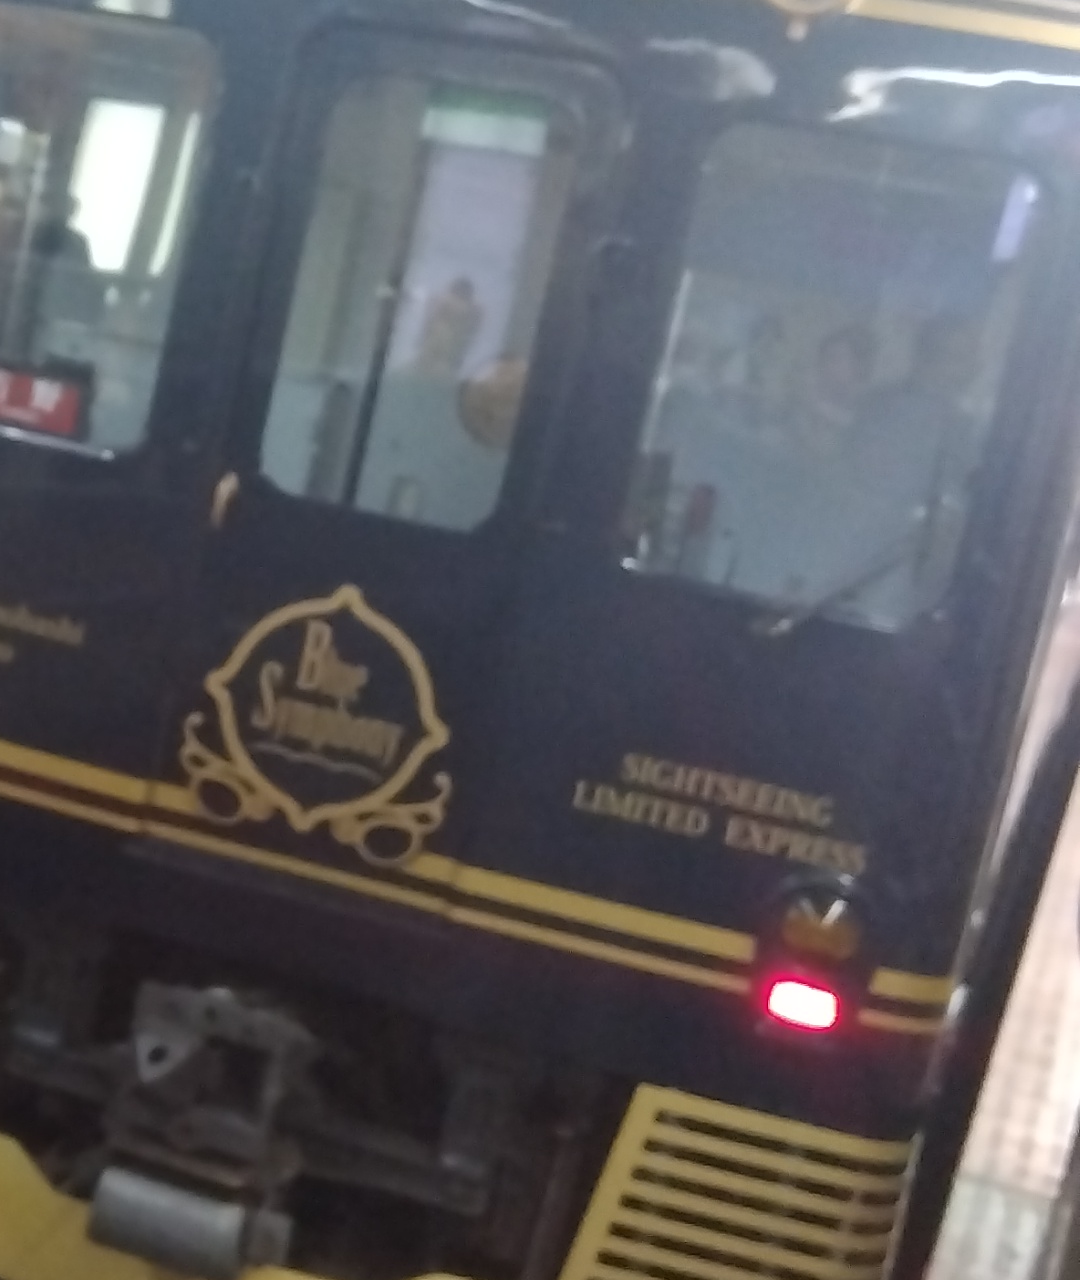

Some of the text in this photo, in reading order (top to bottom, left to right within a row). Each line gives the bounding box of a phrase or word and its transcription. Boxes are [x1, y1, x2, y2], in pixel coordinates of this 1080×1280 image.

[573, 780, 866, 875] LIMITED EXPRESS
[623, 752, 834, 827] SIGHTSEEING
